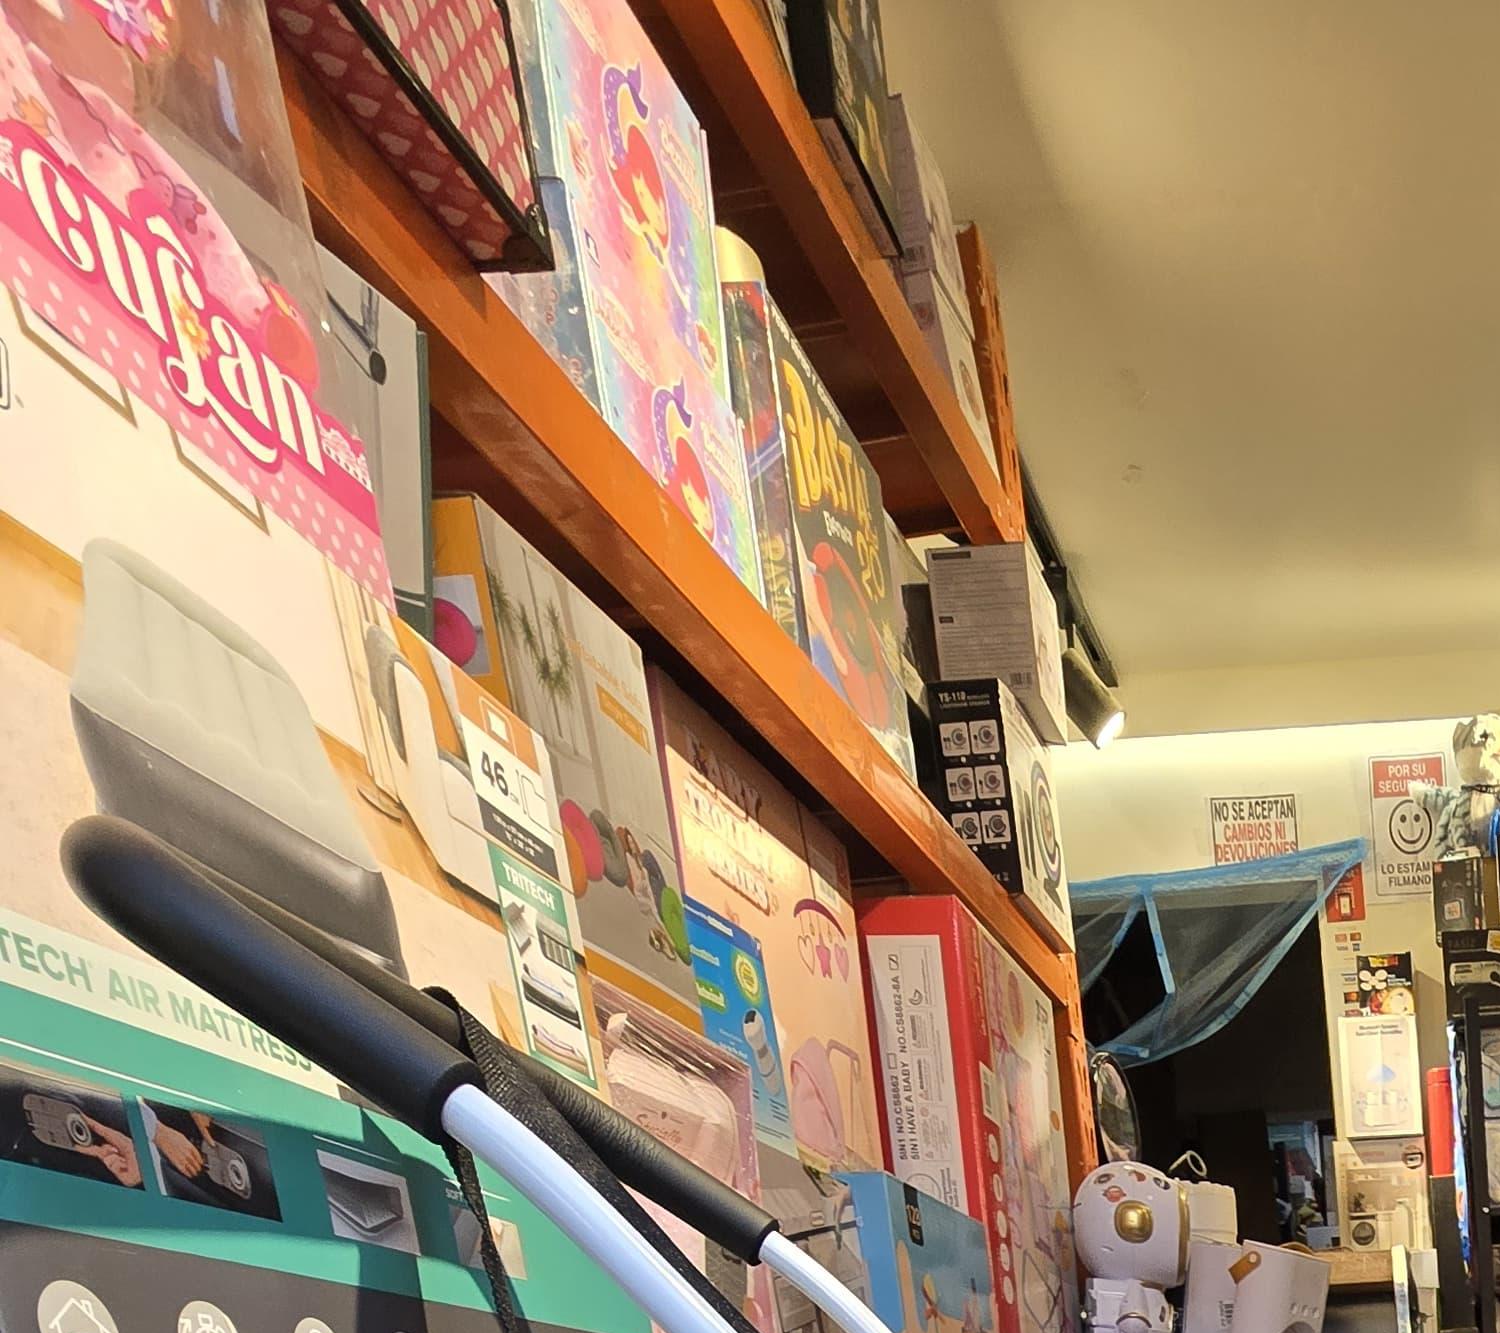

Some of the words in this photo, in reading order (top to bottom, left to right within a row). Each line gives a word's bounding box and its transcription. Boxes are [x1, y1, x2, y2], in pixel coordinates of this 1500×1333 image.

[480, 750, 509, 797] 46
[1388, 763, 1411, 778] POR
[1411, 762, 1426, 777] SU
[1378, 777, 1437, 793] SEGUAD
[1214, 801, 1229, 823] NO
[1231, 800, 1245, 821] SE
[1247, 798, 1294, 820] ACEPTAN
[1223, 821, 1272, 843] CAMBIOS
[1275, 821, 1287, 839] NI
[1215, 839, 1298, 863] DEVOLUCIONES
[1381, 864, 1395, 875] LO
[1397, 861, 1431, 874] ESTAM
[501, 860, 556, 912] TRITECH
[1388, 873, 1432, 888] FILMAND
[0, 927, 93, 994] TECH
[107, 966, 165, 1019] AIR
[901, 1060, 914, 1094] BABY
[905, 1104, 918, 1137] HAVE
